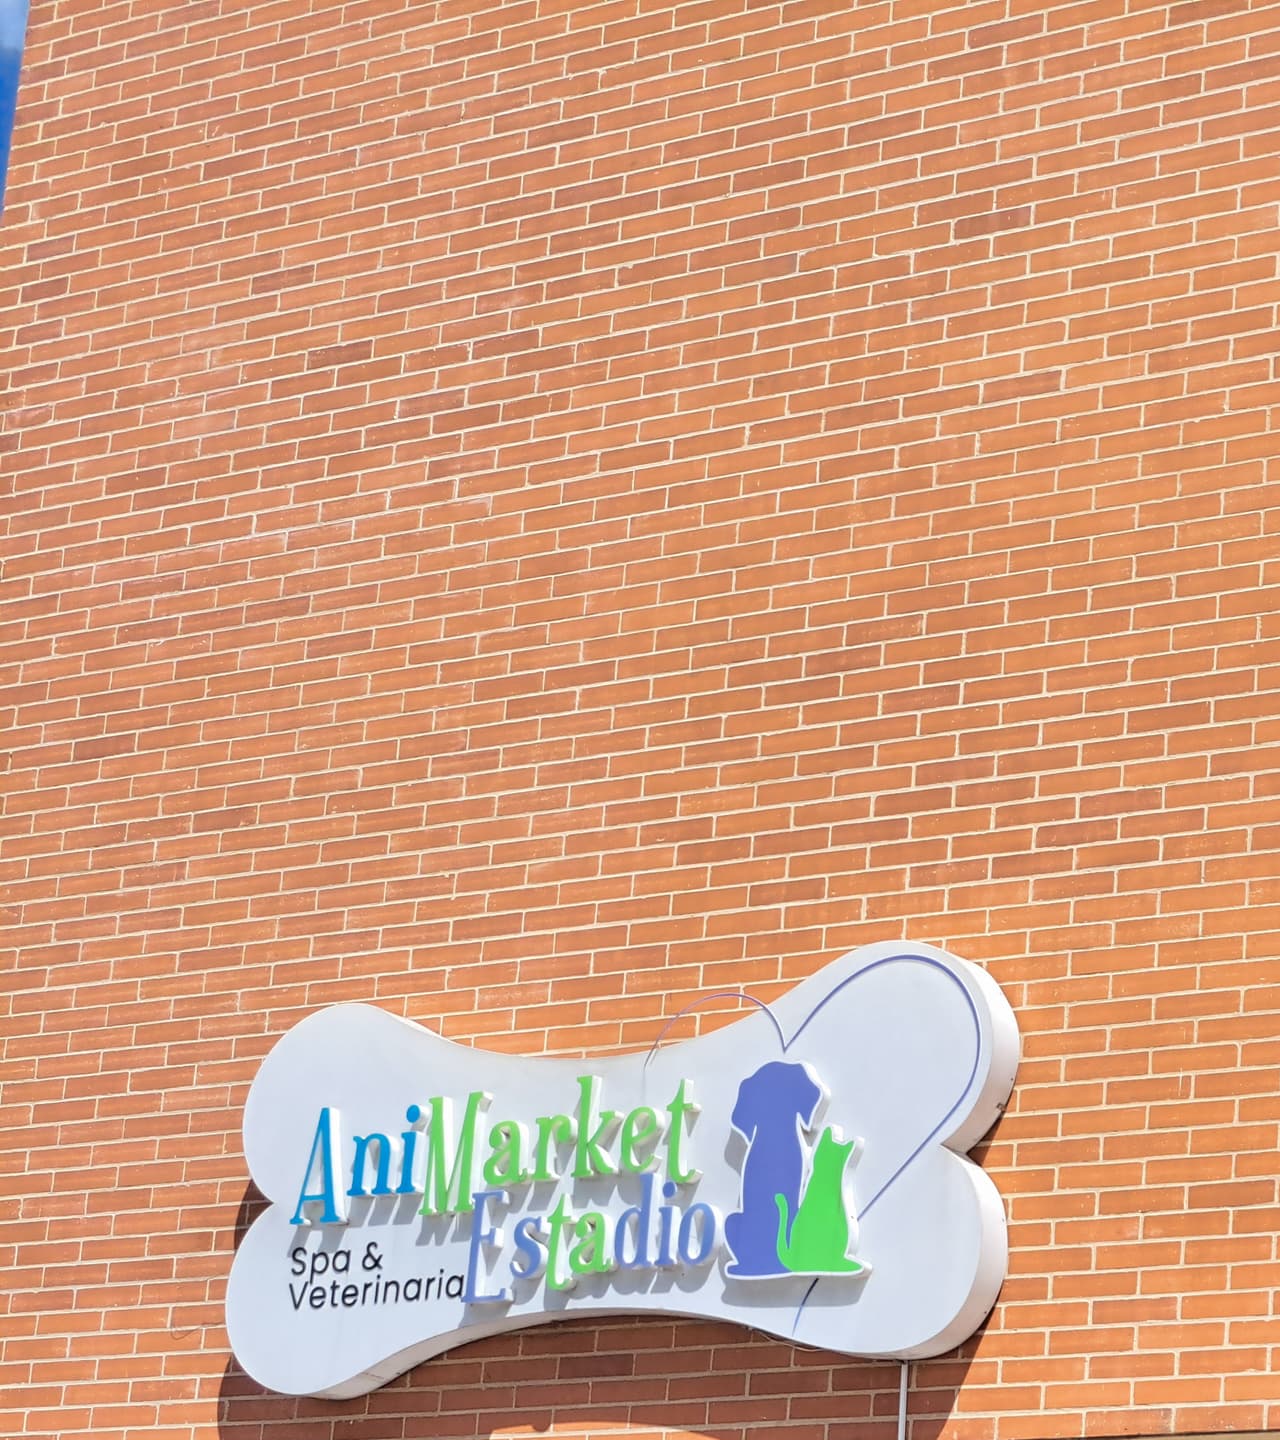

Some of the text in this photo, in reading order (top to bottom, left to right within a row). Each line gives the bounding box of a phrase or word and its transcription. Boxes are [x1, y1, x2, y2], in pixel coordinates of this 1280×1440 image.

[290, 1076, 700, 1224] AniMarket
[291, 1241, 383, 1285] Spa &
[461, 1173, 718, 1305] Estadio
[289, 1268, 464, 1311] Veterinaria
